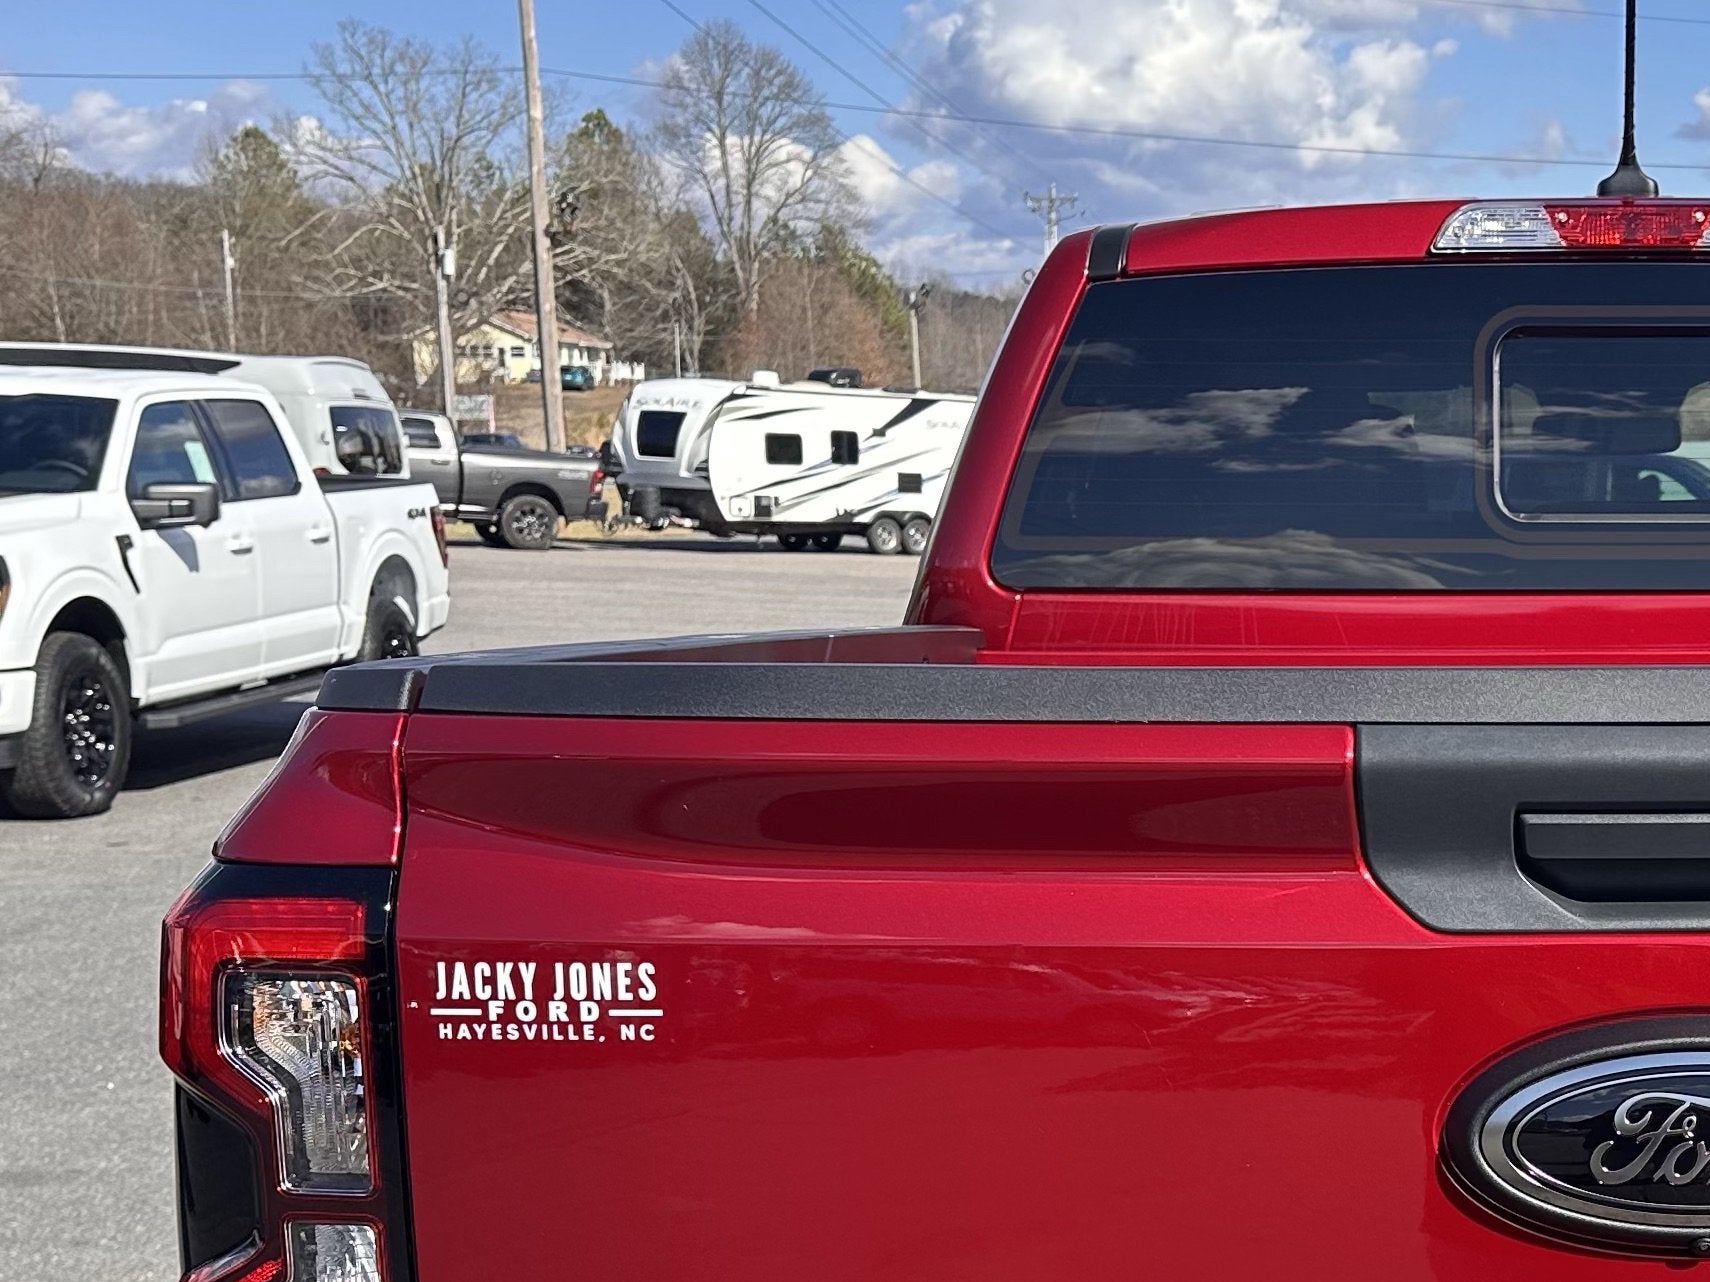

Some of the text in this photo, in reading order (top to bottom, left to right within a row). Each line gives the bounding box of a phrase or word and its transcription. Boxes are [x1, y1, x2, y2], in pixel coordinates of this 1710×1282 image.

[436, 961, 657, 1001] JACKY JONES
[488, 1000, 600, 1022] FORD
[438, 1023, 655, 1042] HAYESVILLE, NC
